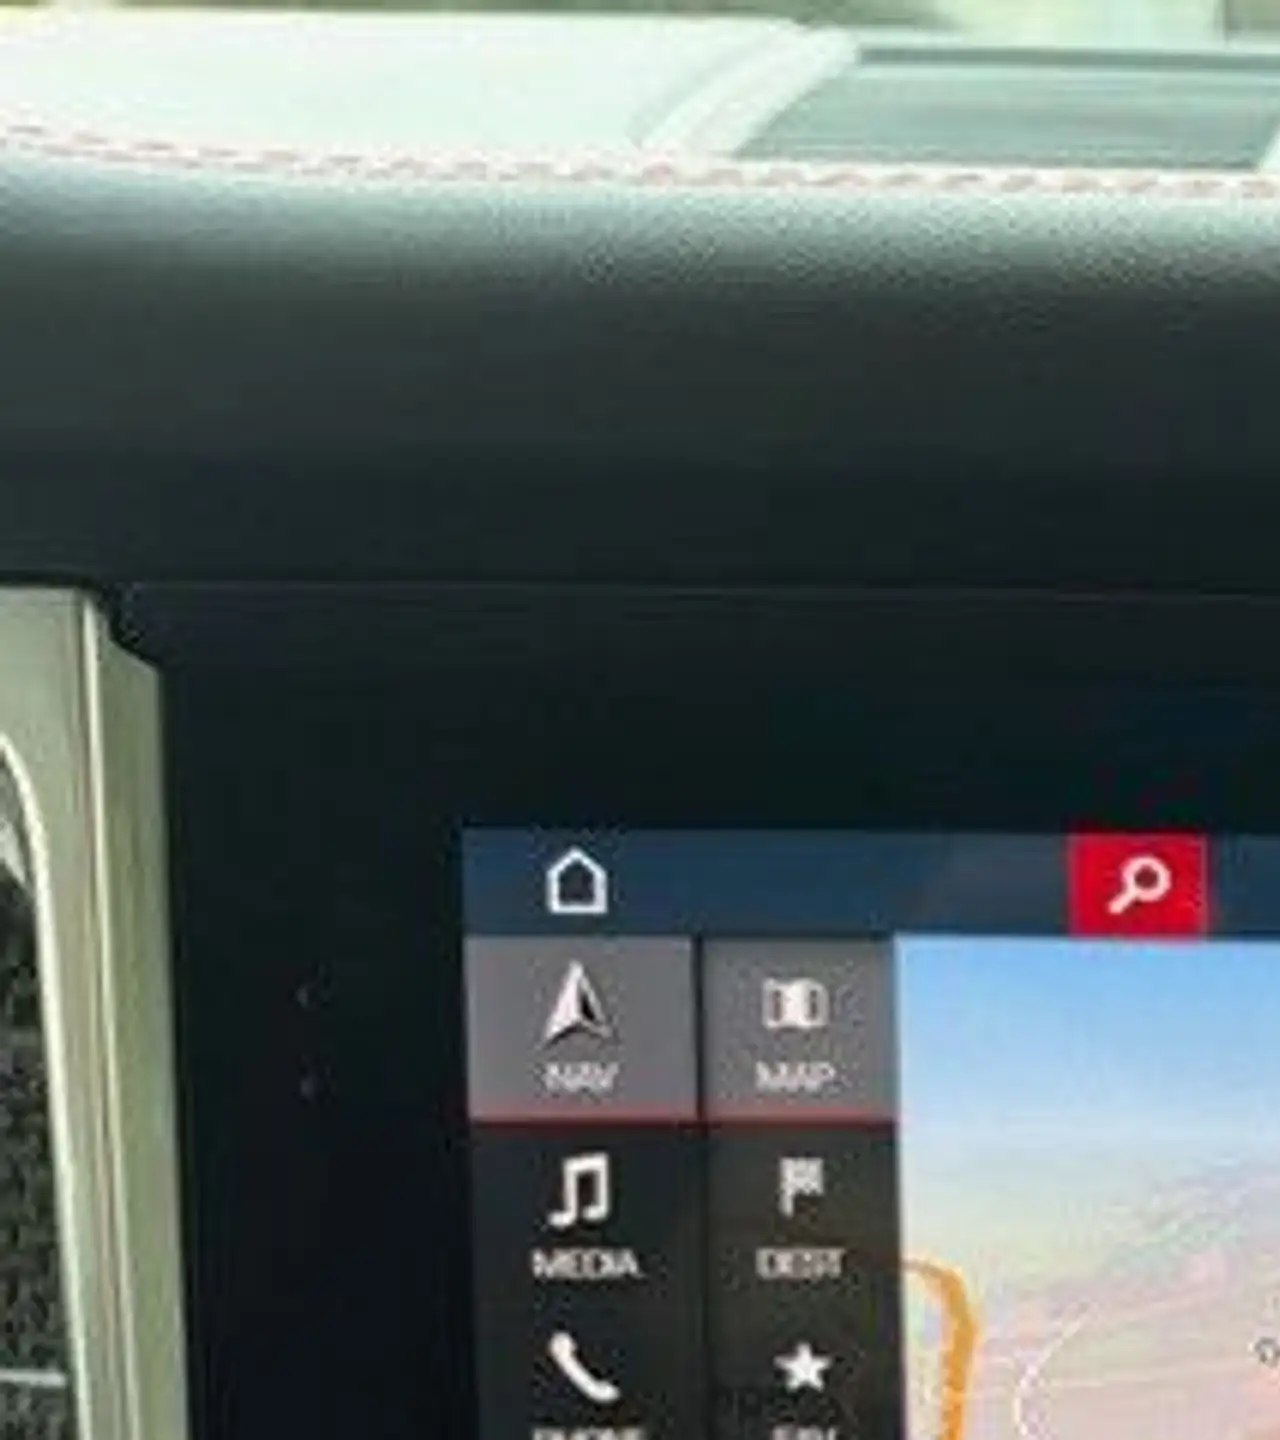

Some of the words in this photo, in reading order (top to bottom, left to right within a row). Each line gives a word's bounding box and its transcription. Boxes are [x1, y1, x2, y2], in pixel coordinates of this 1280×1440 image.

[545, 1063, 618, 1094] NAV
[756, 1062, 838, 1094] MAP
[532, 1248, 640, 1280] MEDIA
[756, 1248, 845, 1280] DEST
